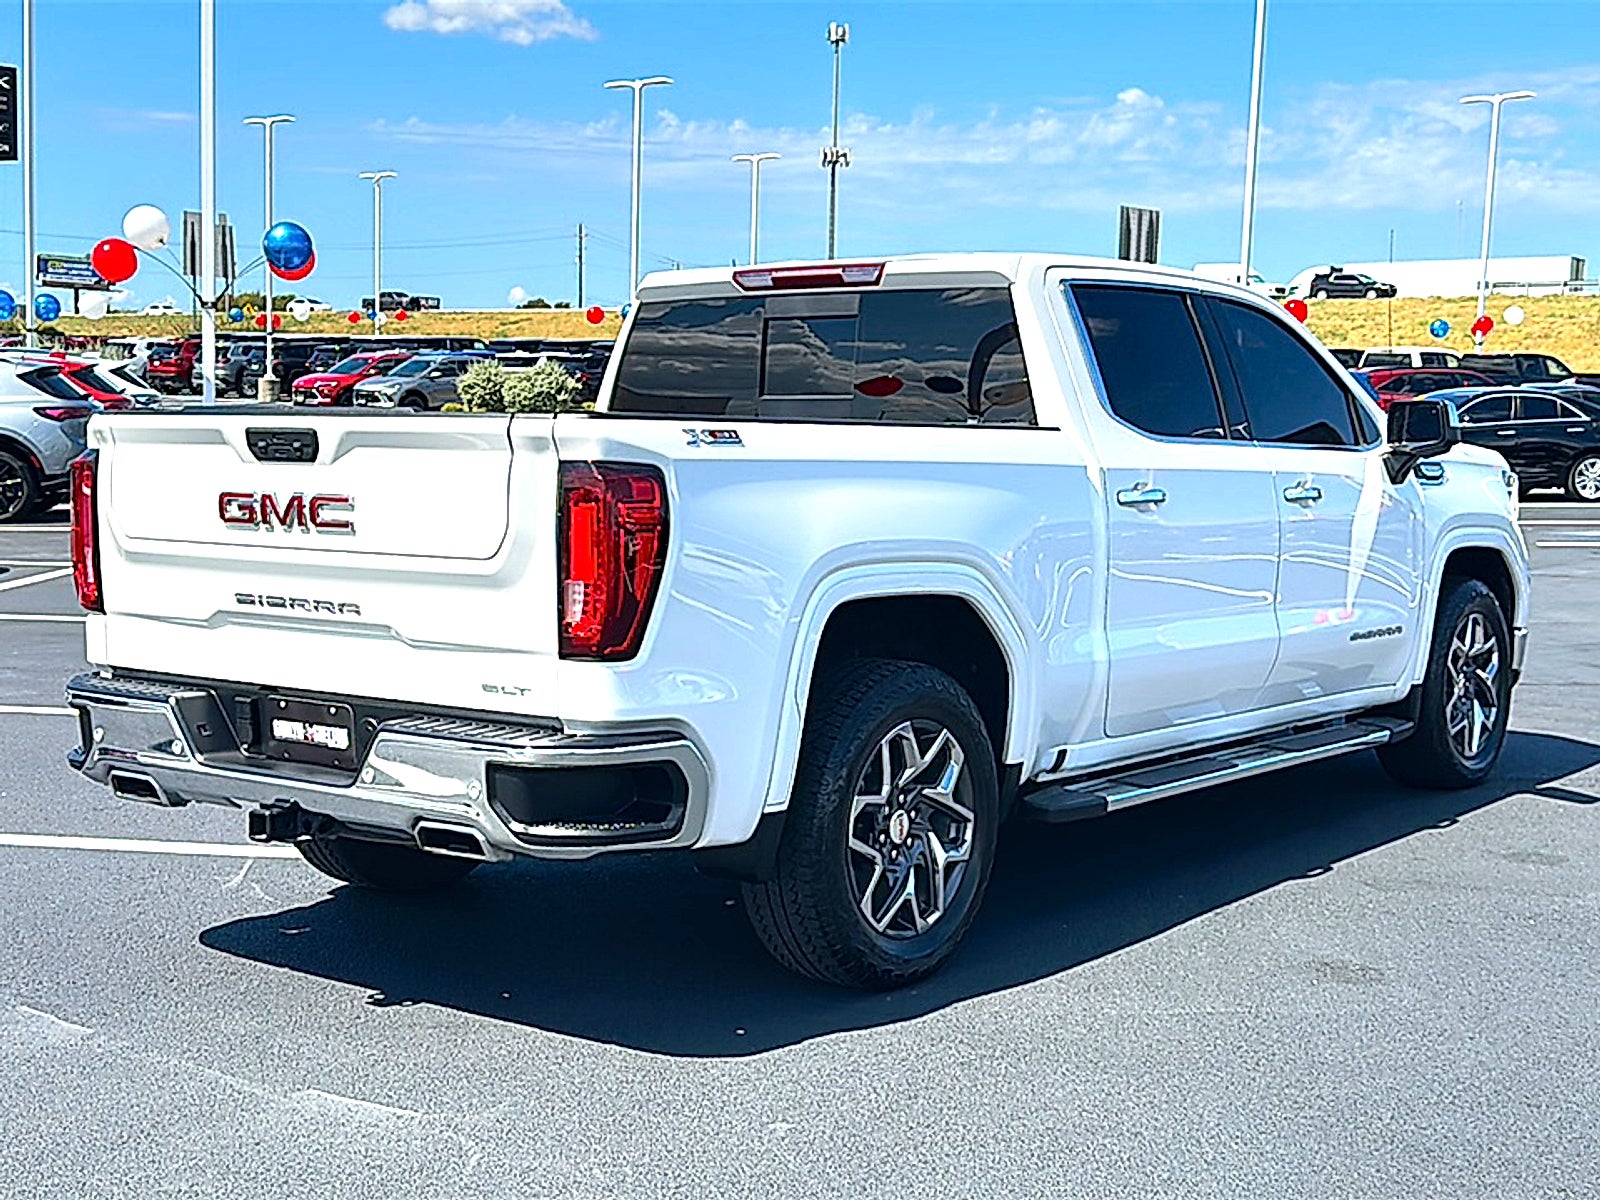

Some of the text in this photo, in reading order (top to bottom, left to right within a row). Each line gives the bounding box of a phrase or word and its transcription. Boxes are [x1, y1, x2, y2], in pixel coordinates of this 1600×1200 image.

[219, 491, 356, 536] GMC
[235, 592, 361, 616] SIERRA
[481, 683, 532, 696] SLT
